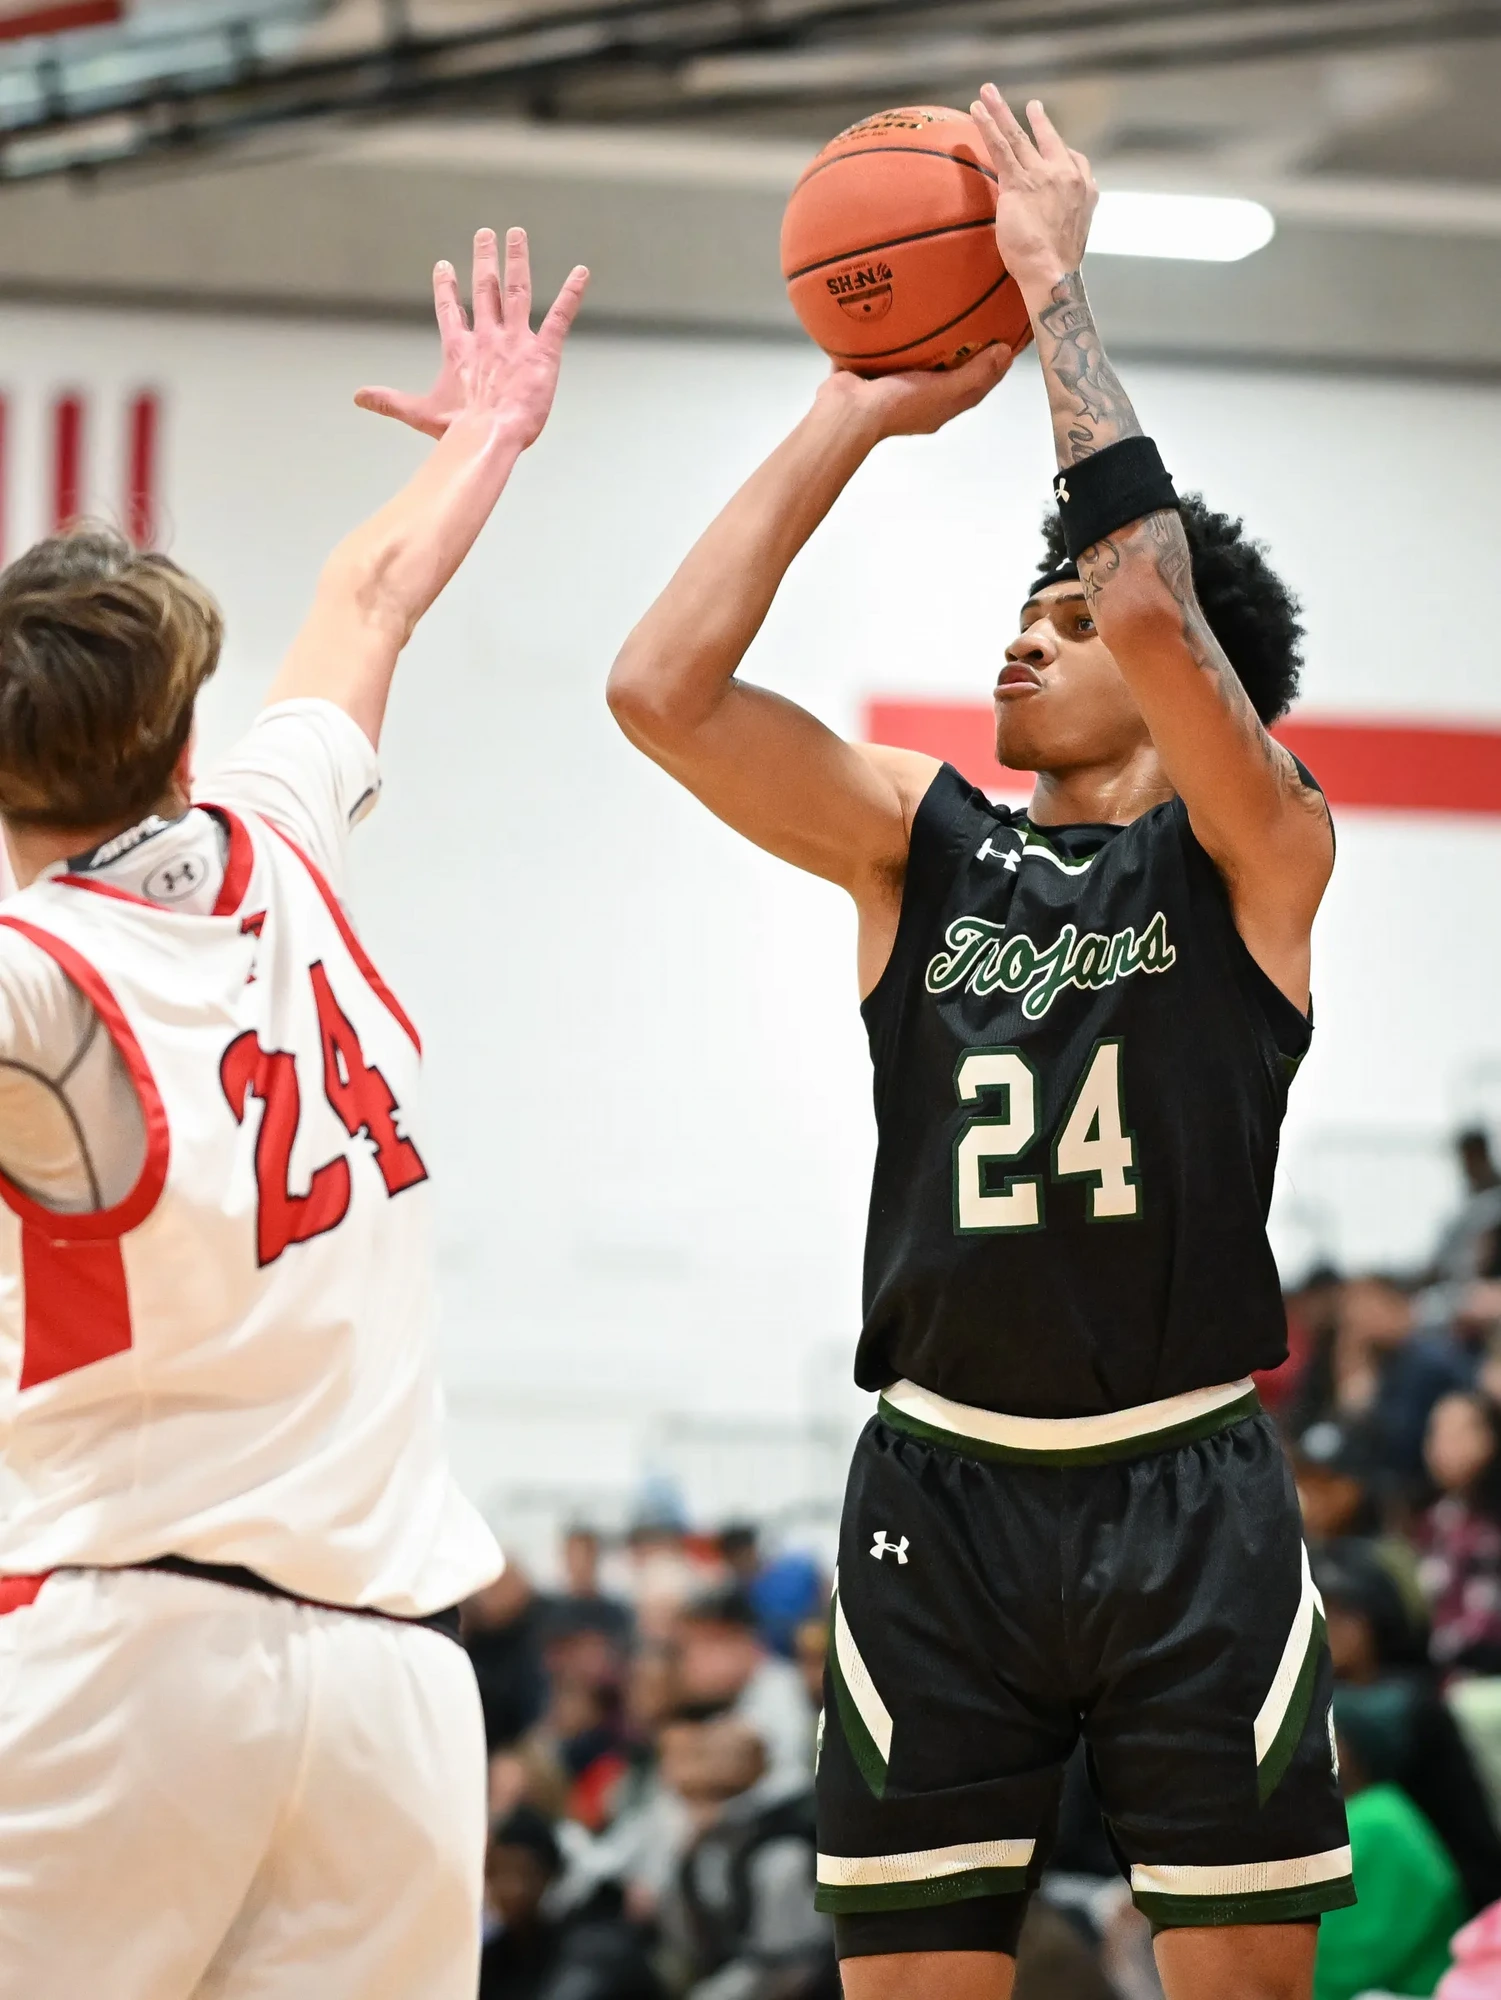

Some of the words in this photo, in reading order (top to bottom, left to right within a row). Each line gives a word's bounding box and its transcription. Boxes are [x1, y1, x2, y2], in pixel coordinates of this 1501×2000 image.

[826, 268, 877, 295] NFHS
[925, 911, 1176, 1020] Trojans
[219, 959, 429, 1268] 24
[953, 1037, 1143, 1235] 24
